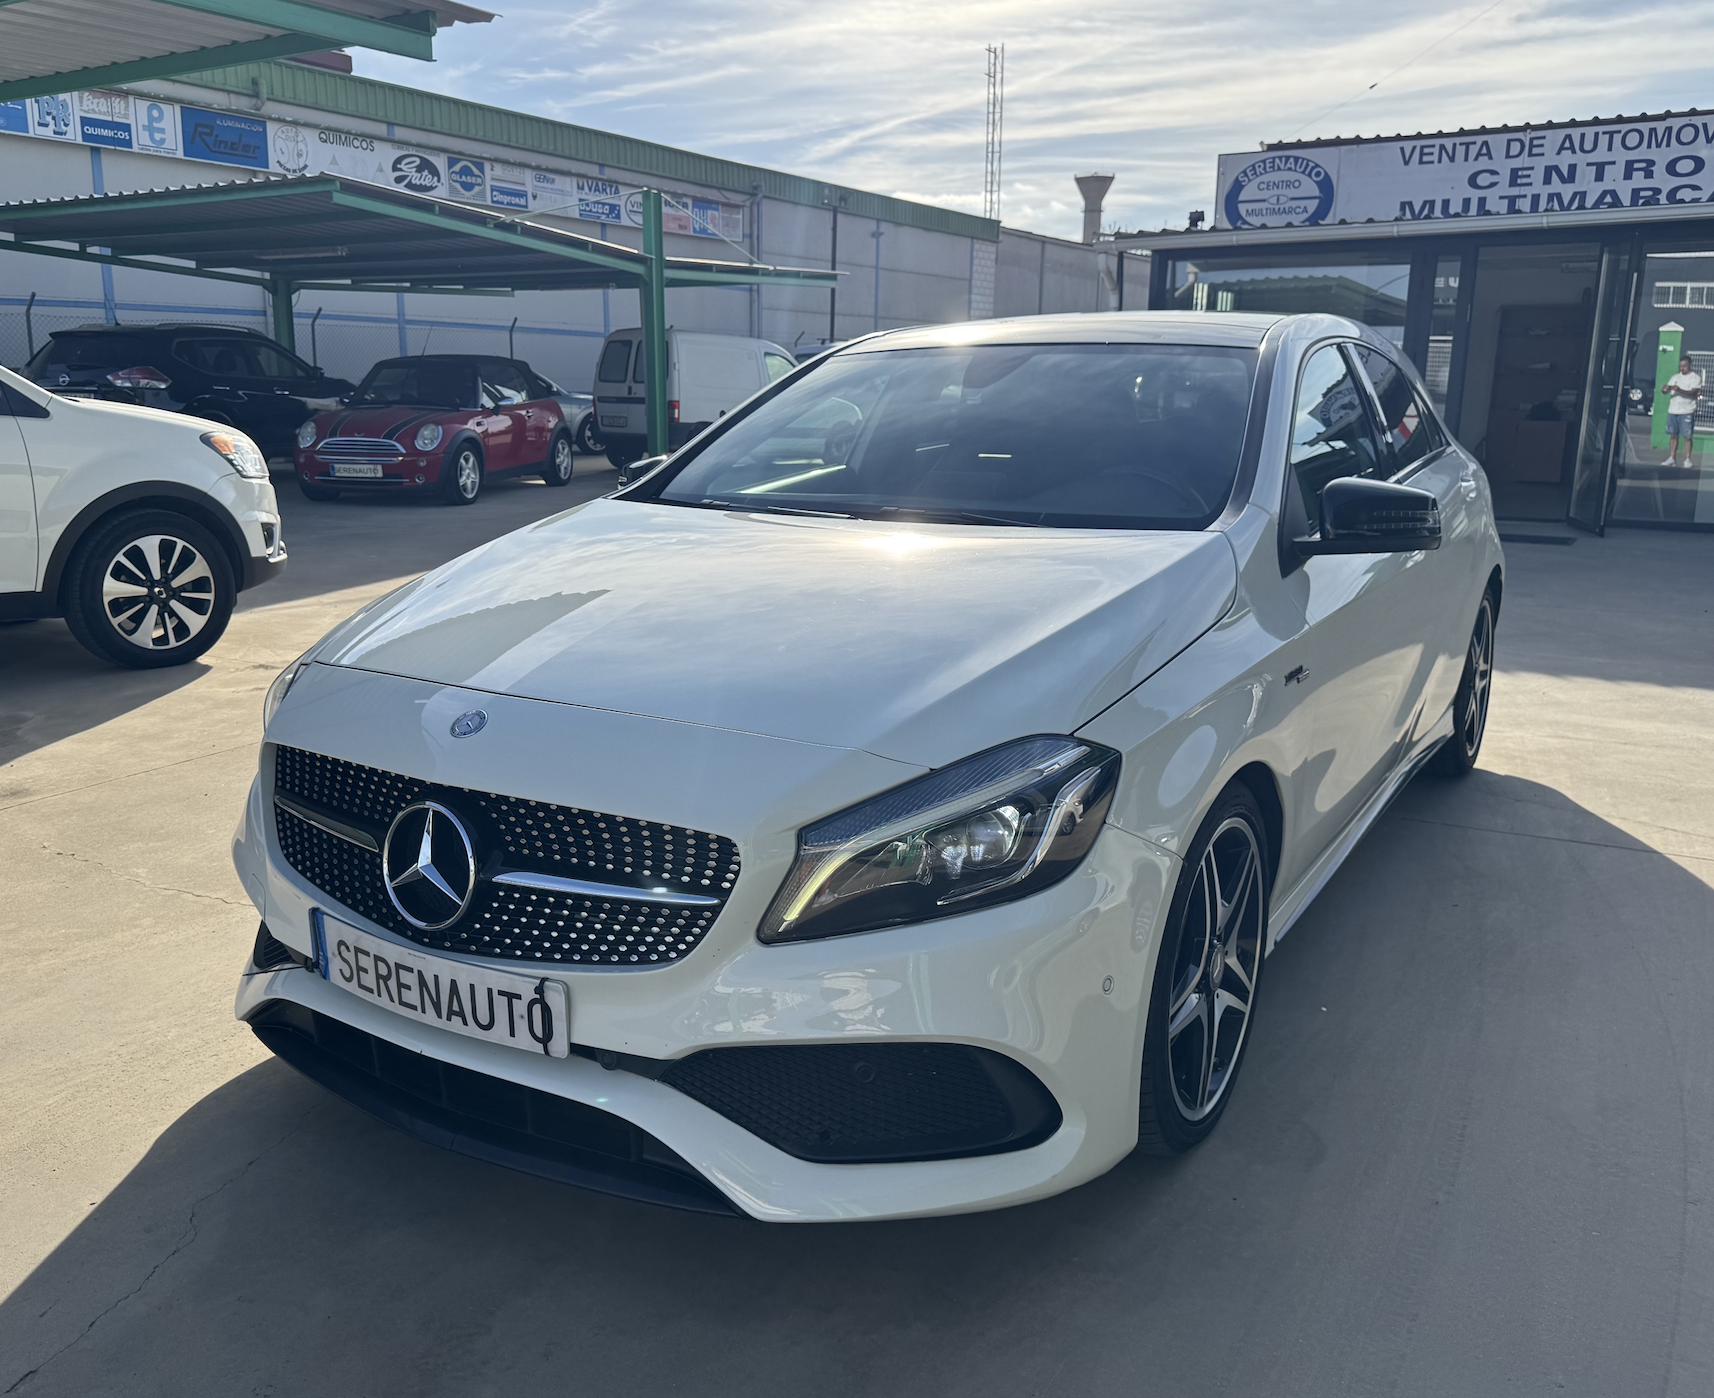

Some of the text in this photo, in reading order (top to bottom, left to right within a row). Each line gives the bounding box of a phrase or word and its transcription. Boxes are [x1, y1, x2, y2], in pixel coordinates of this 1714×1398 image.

[83, 125, 131, 140] QUIMICOS
[190, 122, 261, 157] Rinder
[318, 131, 375, 152] QUIMICOS
[1399, 140, 1494, 166] VENTA
[1505, 134, 1546, 160] DE
[393, 156, 443, 188] Gates
[450, 172, 484, 185] GLASER
[1237, 157, 1325, 186] SERENAUTO
[1467, 155, 1705, 191] CENTRO
[586, 179, 620, 196] VARTA
[1257, 179, 1302, 192] CENTRO
[1245, 206, 1309, 218] MULTIMARCA
[1398, 182, 1714, 220] MULTIMARC
[335, 466, 379, 475] SERENAUTO
[336, 939, 554, 1045] SERENAUTO
